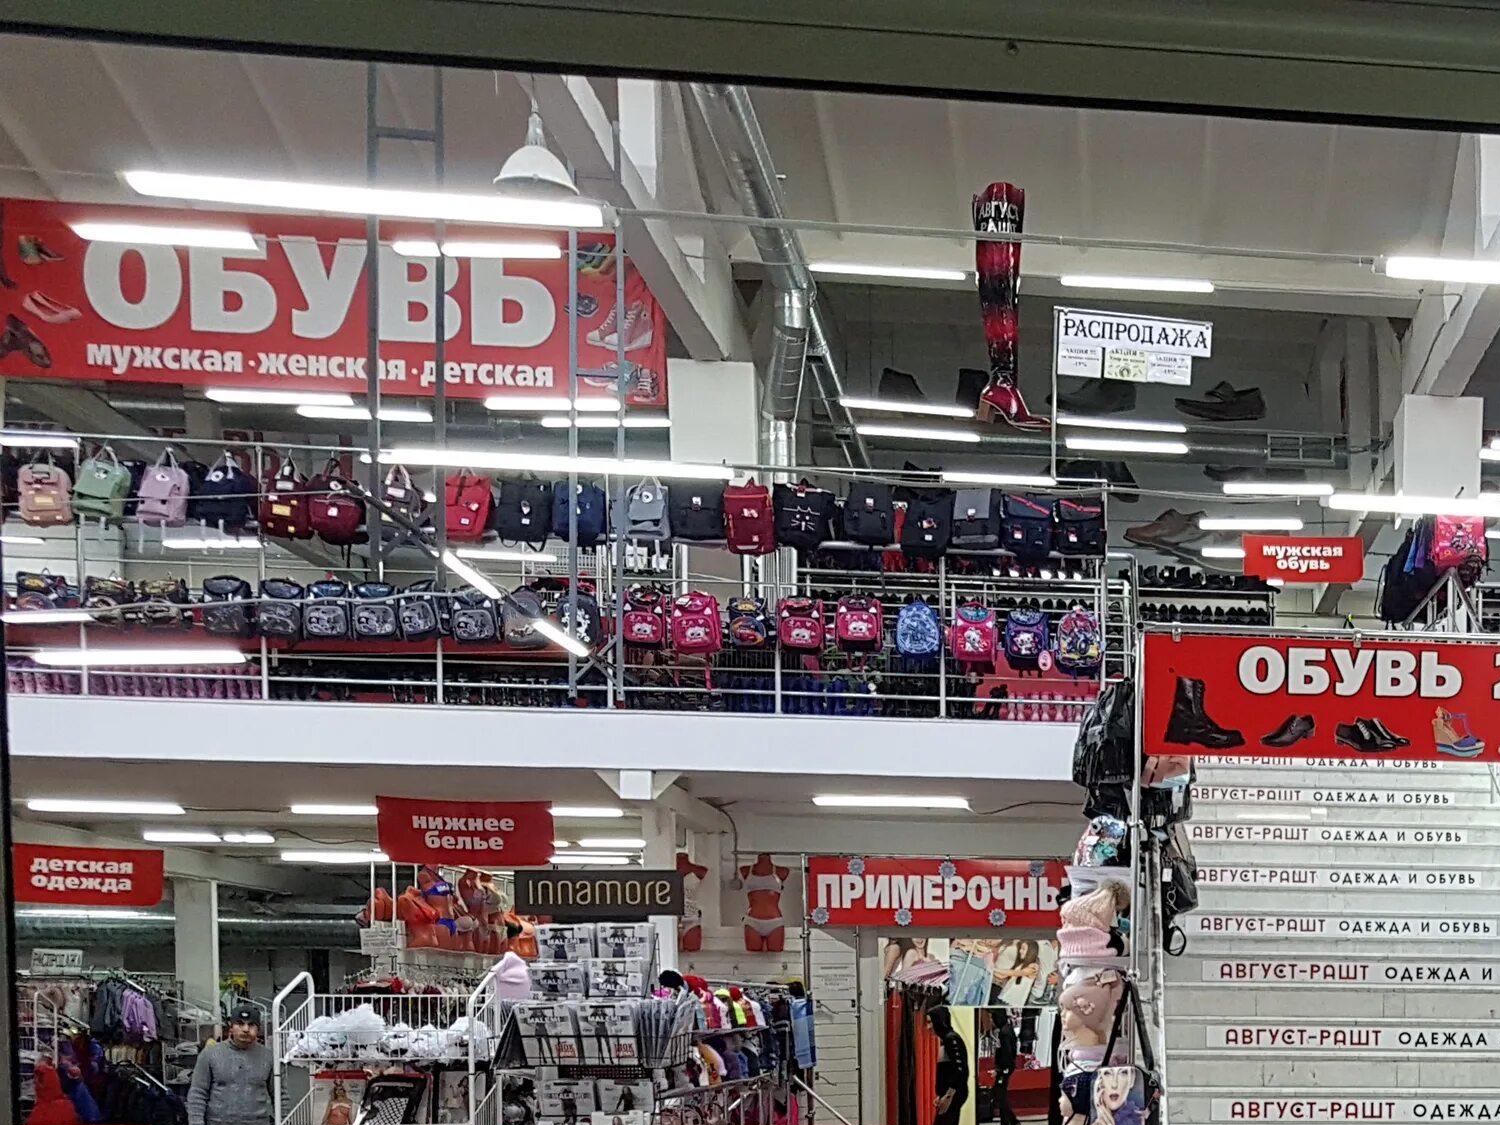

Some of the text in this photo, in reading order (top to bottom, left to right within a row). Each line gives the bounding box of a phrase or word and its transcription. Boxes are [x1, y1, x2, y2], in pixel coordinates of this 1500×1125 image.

[979, 201, 1018, 221] АВГУСТ
[83, 235, 557, 348] ОБУВЬ
[1063, 318, 1208, 349] РАСПРОДАЖА
[87, 343, 554, 388] мужская женская детская
[1262, 545, 1343, 559] мужская
[1276, 556, 1330, 573] обувь
[1237, 645, 1463, 700] ОБУВЬ
[1313, 791, 1379, 803] ОДЕЖДА
[1386, 793, 1394, 803] И
[1404, 793, 1449, 804] ОБУВЬ
[411, 814, 515, 835] нижнее
[424, 830, 504, 852] белье
[1193, 827, 1462, 843] АВГУСТ-РАШТ ОДЕЖДА И ОБУВЬ
[30, 857, 134, 874] детская
[31, 875, 133, 893] одежда
[1197, 869, 1475, 885] АВГУСТ-РАШТ ОДЕЖДА И ОБУВЬ
[529, 880, 671, 905] innamore
[816, 873, 1068, 911] ПРИМЕРОЧНЫ
[1201, 918, 1491, 933] АВГУСТ-РАШТ ОДЕЖДА И ОБУВЬ
[1220, 963, 1369, 980] АВГУСТ-РАШТ
[1385, 965, 1470, 981] ОДЕЖДА
[1482, 967, 1492, 980] И
[1226, 1028, 1382, 1045] АВГУСТ-РАШТ
[1399, 1031, 1487, 1047] ОДЕЖДА
[1231, 1102, 1395, 1118] АВГУСТ-РАШТ
